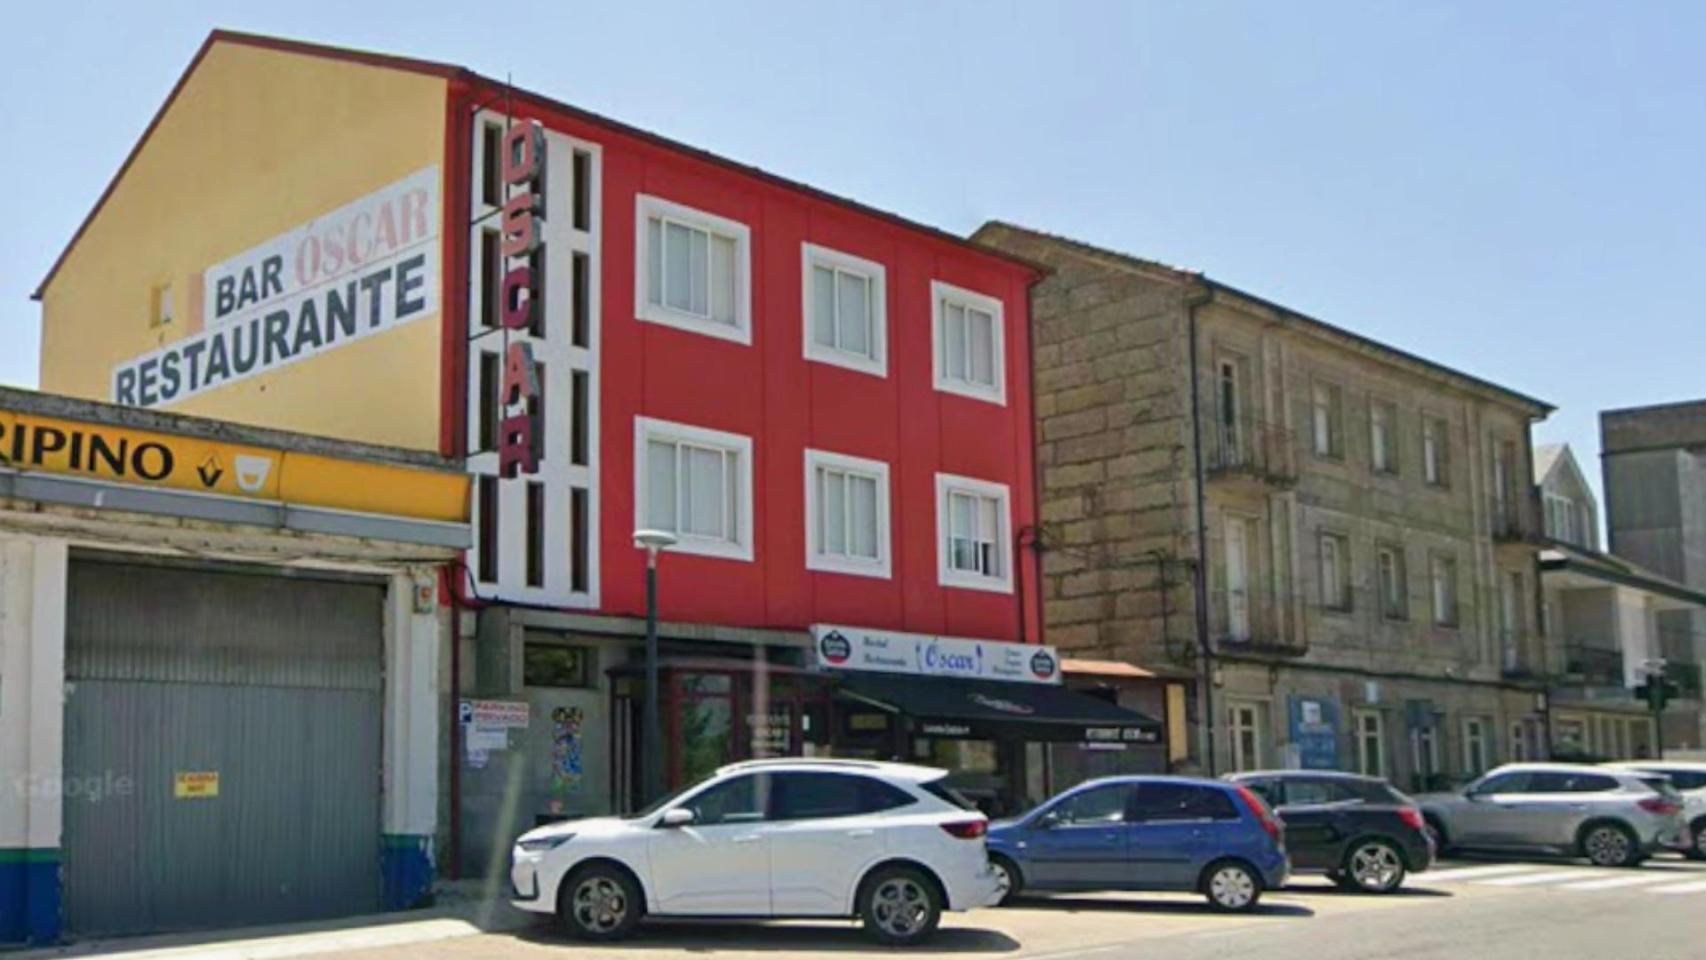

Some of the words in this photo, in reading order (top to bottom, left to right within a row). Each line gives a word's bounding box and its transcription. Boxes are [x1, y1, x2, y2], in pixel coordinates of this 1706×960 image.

[215, 254, 284, 319] BAR
[295, 187, 429, 288] ÓSCAR
[499, 118, 544, 479] OSCAR
[116, 253, 427, 408] RESTAURANTE
[0, 421, 174, 481] IPINO
[925, 635, 975, 670] Óscar
